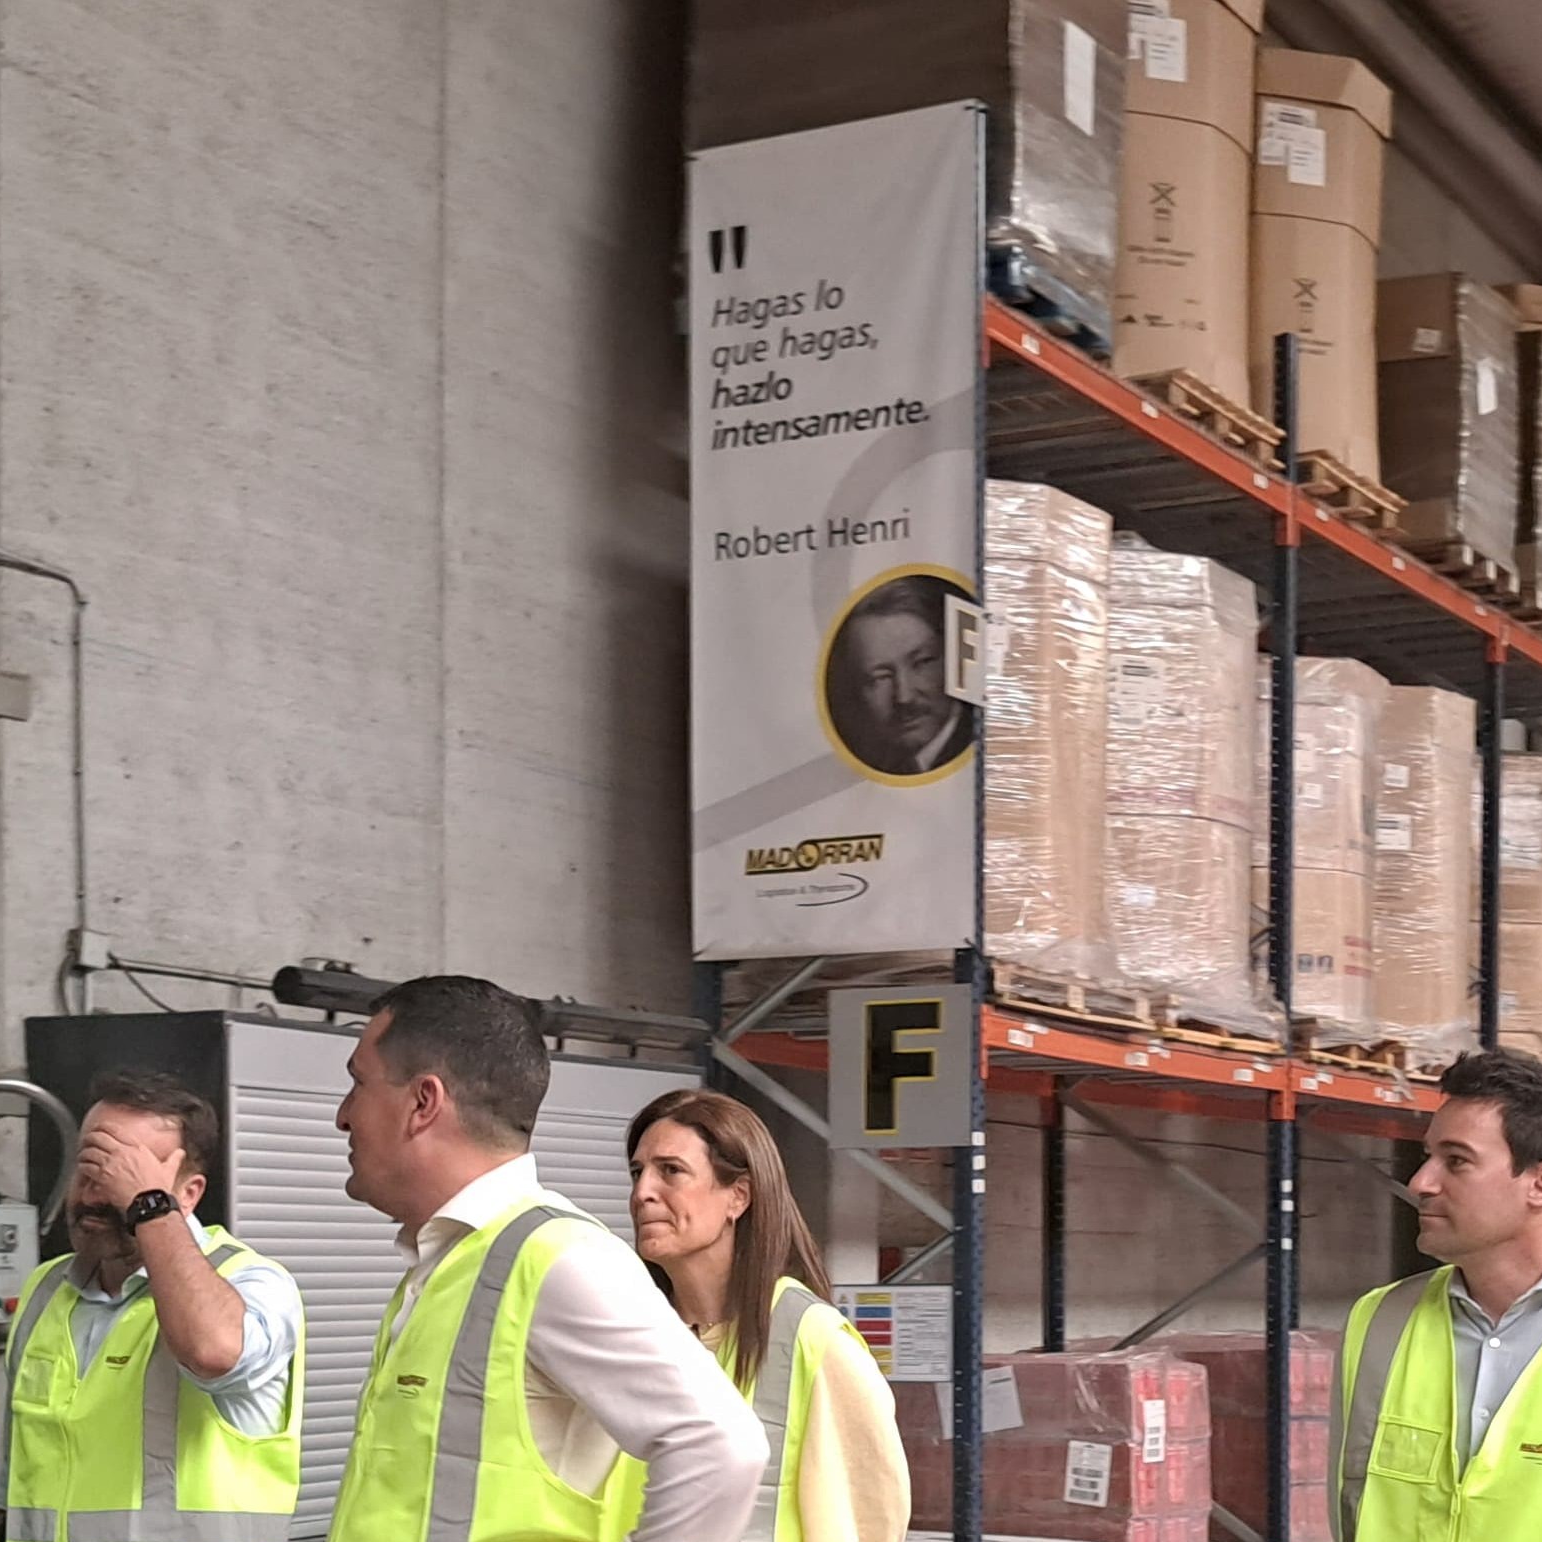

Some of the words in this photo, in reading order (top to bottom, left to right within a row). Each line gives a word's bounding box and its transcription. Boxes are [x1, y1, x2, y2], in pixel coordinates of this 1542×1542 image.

[711, 289, 805, 329] Hagas
[814, 279, 845, 312] lo
[711, 338, 768, 374] que
[778, 322, 879, 361] hagas,
[710, 371, 793, 410] hazlo
[711, 397, 932, 451] intensamente.
[714, 523, 817, 561] Robert
[827, 507, 910, 549] Henri
[955, 608, 979, 693] F
[745, 834, 884, 875] MADORRAN
[863, 997, 945, 1137] F
